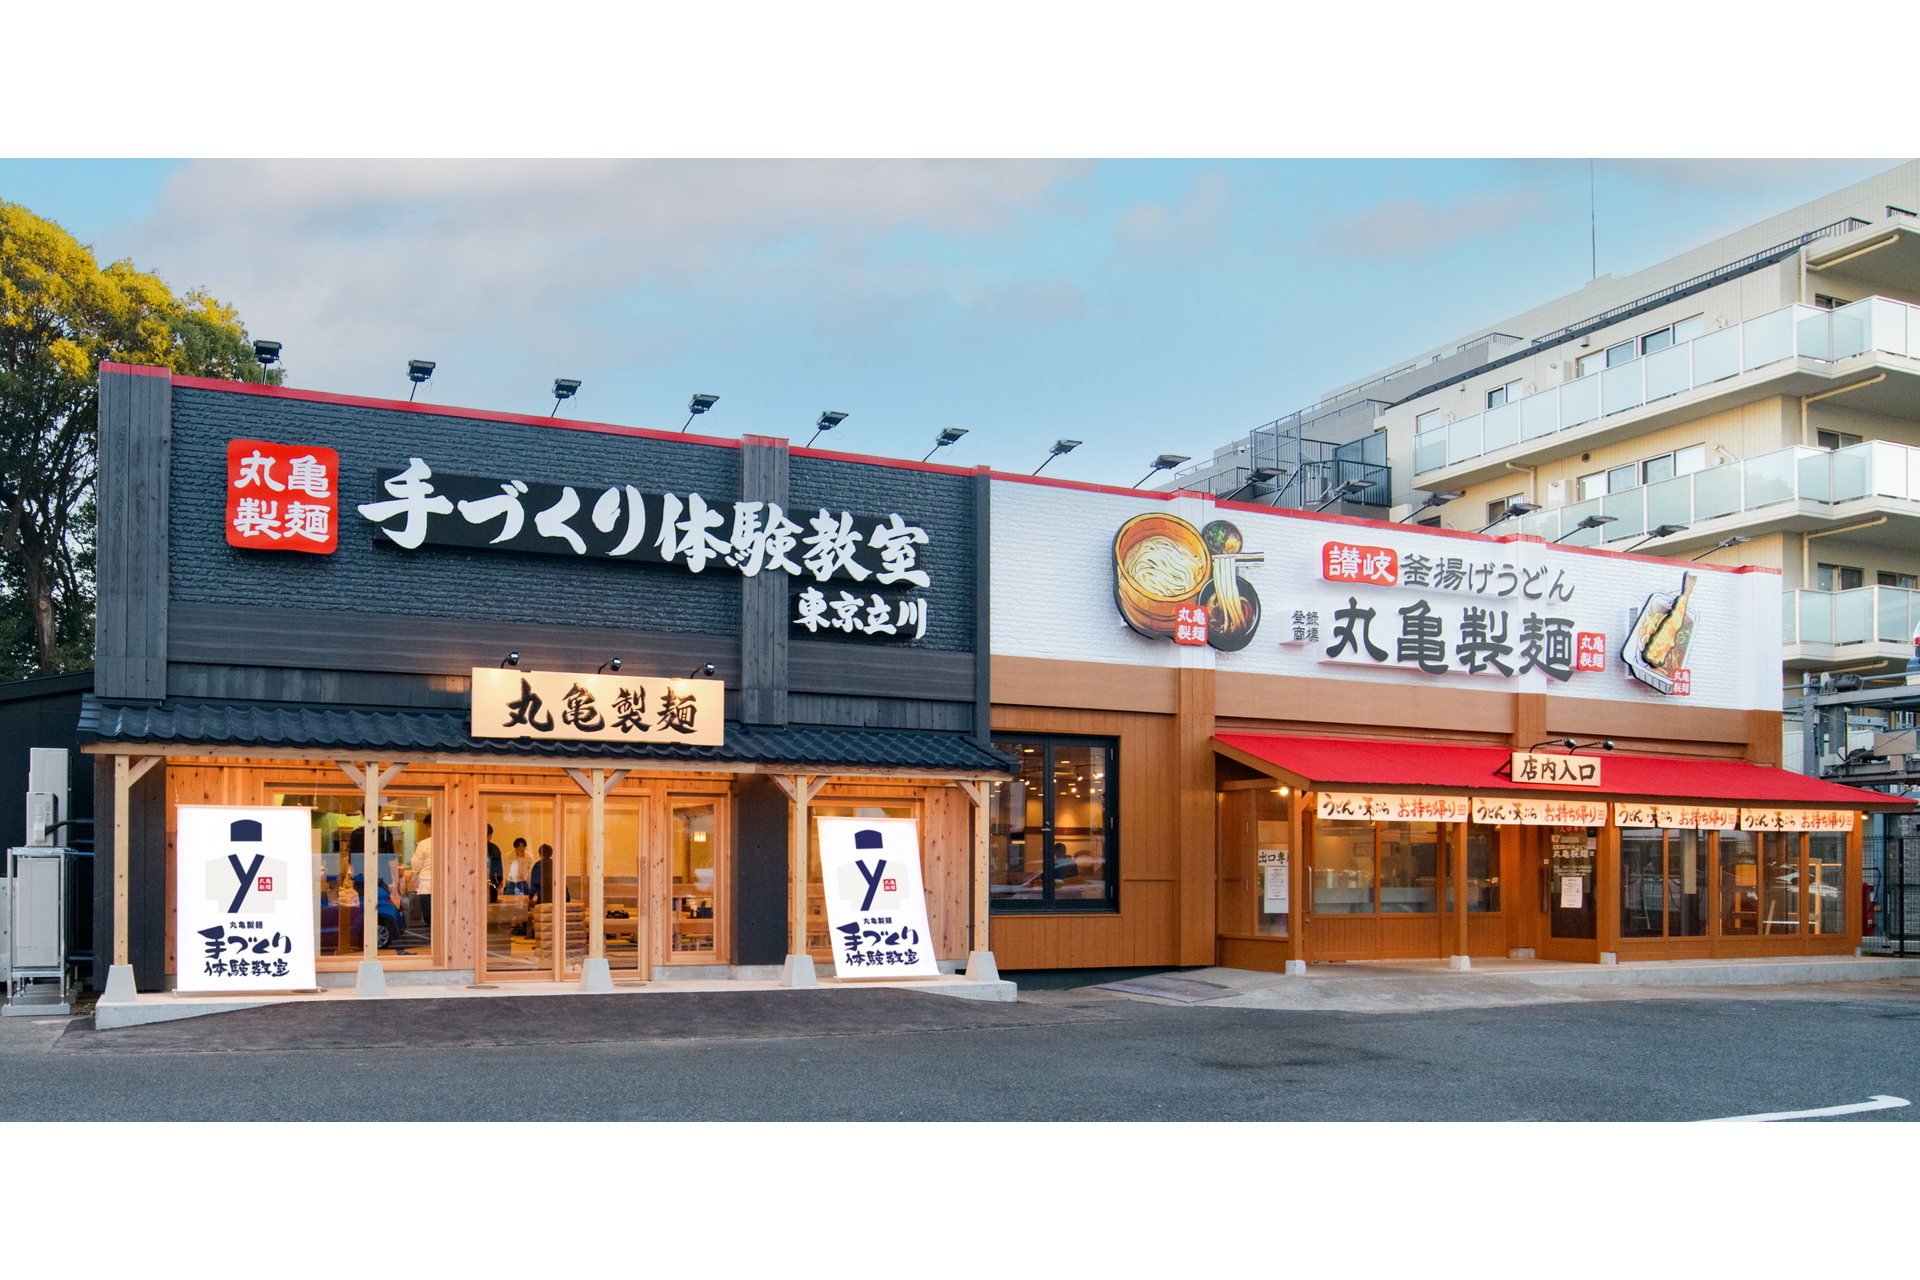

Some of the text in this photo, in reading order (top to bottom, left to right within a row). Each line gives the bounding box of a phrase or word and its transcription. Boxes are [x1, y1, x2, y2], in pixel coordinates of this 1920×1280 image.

[234, 450, 331, 498] 丸亀
[233, 497, 331, 543] 製麺
[358, 457, 931, 588] 手づくり体験教室
[1329, 546, 1575, 602] 讃岐 釜揚げうどん
[792, 586, 928, 640] 東京立川
[1177, 607, 1206, 625] 丸亀
[1292, 610, 1319, 626] 登録
[1177, 624, 1206, 642] 製麺
[1292, 626, 1319, 642] 商標
[1325, 596, 1576, 682] 丸亀製麺
[1580, 635, 1604, 652] 丸亀
[1580, 652, 1604, 668] 製麺
[502, 677, 699, 734] 丸亀製麺
[1520, 755, 1596, 782] 店内入口
[1258, 851, 1289, 865] 出口専
[229, 921, 263, 929] 丸亀製麺
[863, 917, 893, 925] 丸亀製麺
[197, 925, 292, 959] 手づくり
[836, 922, 919, 951] 手づくり
[845, 949, 919, 966] 体験教室
[203, 958, 290, 978] 体験教室
